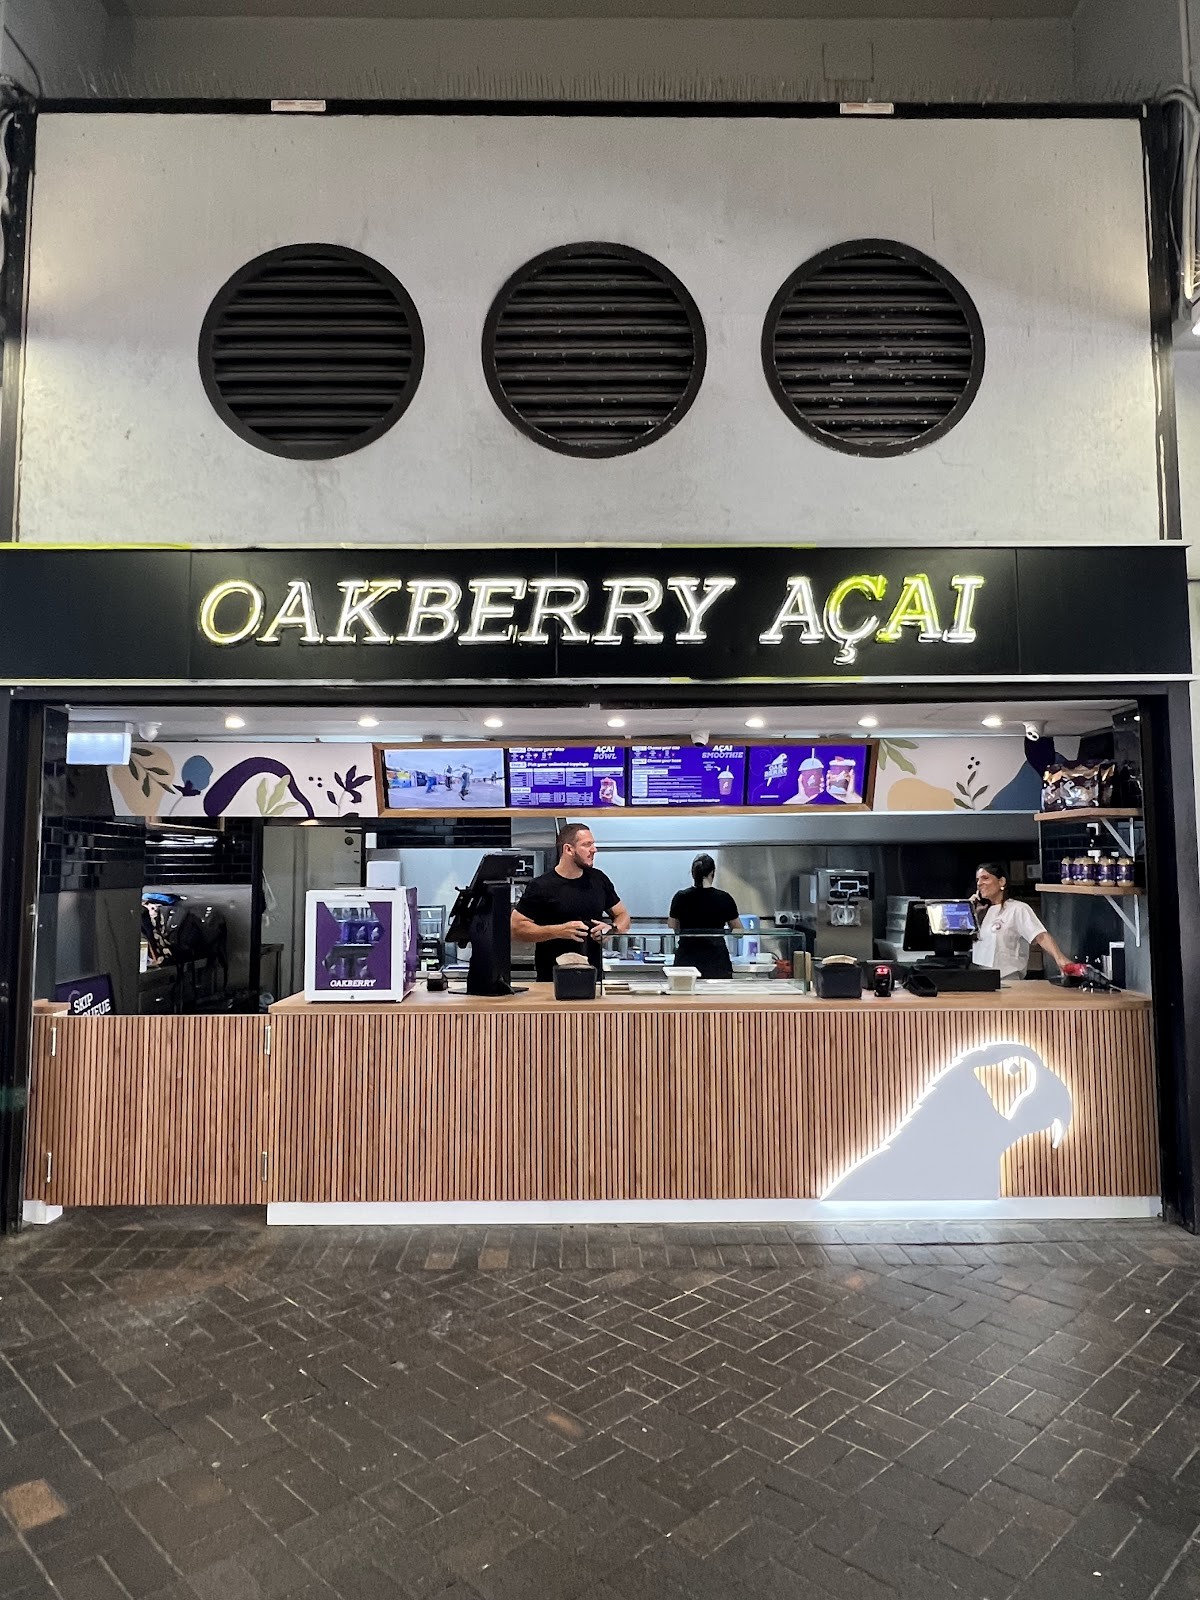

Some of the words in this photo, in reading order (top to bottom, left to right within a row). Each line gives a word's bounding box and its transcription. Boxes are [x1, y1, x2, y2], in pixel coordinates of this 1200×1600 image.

[199, 577, 737, 645] OAKBERRY
[759, 574, 985, 664] AÇAI
[594, 746, 616, 755] AÇAI
[712, 745, 733, 753] AÇAI
[330, 979, 376, 987] OAKBERRY
[73, 992, 94, 1014] SKIP
